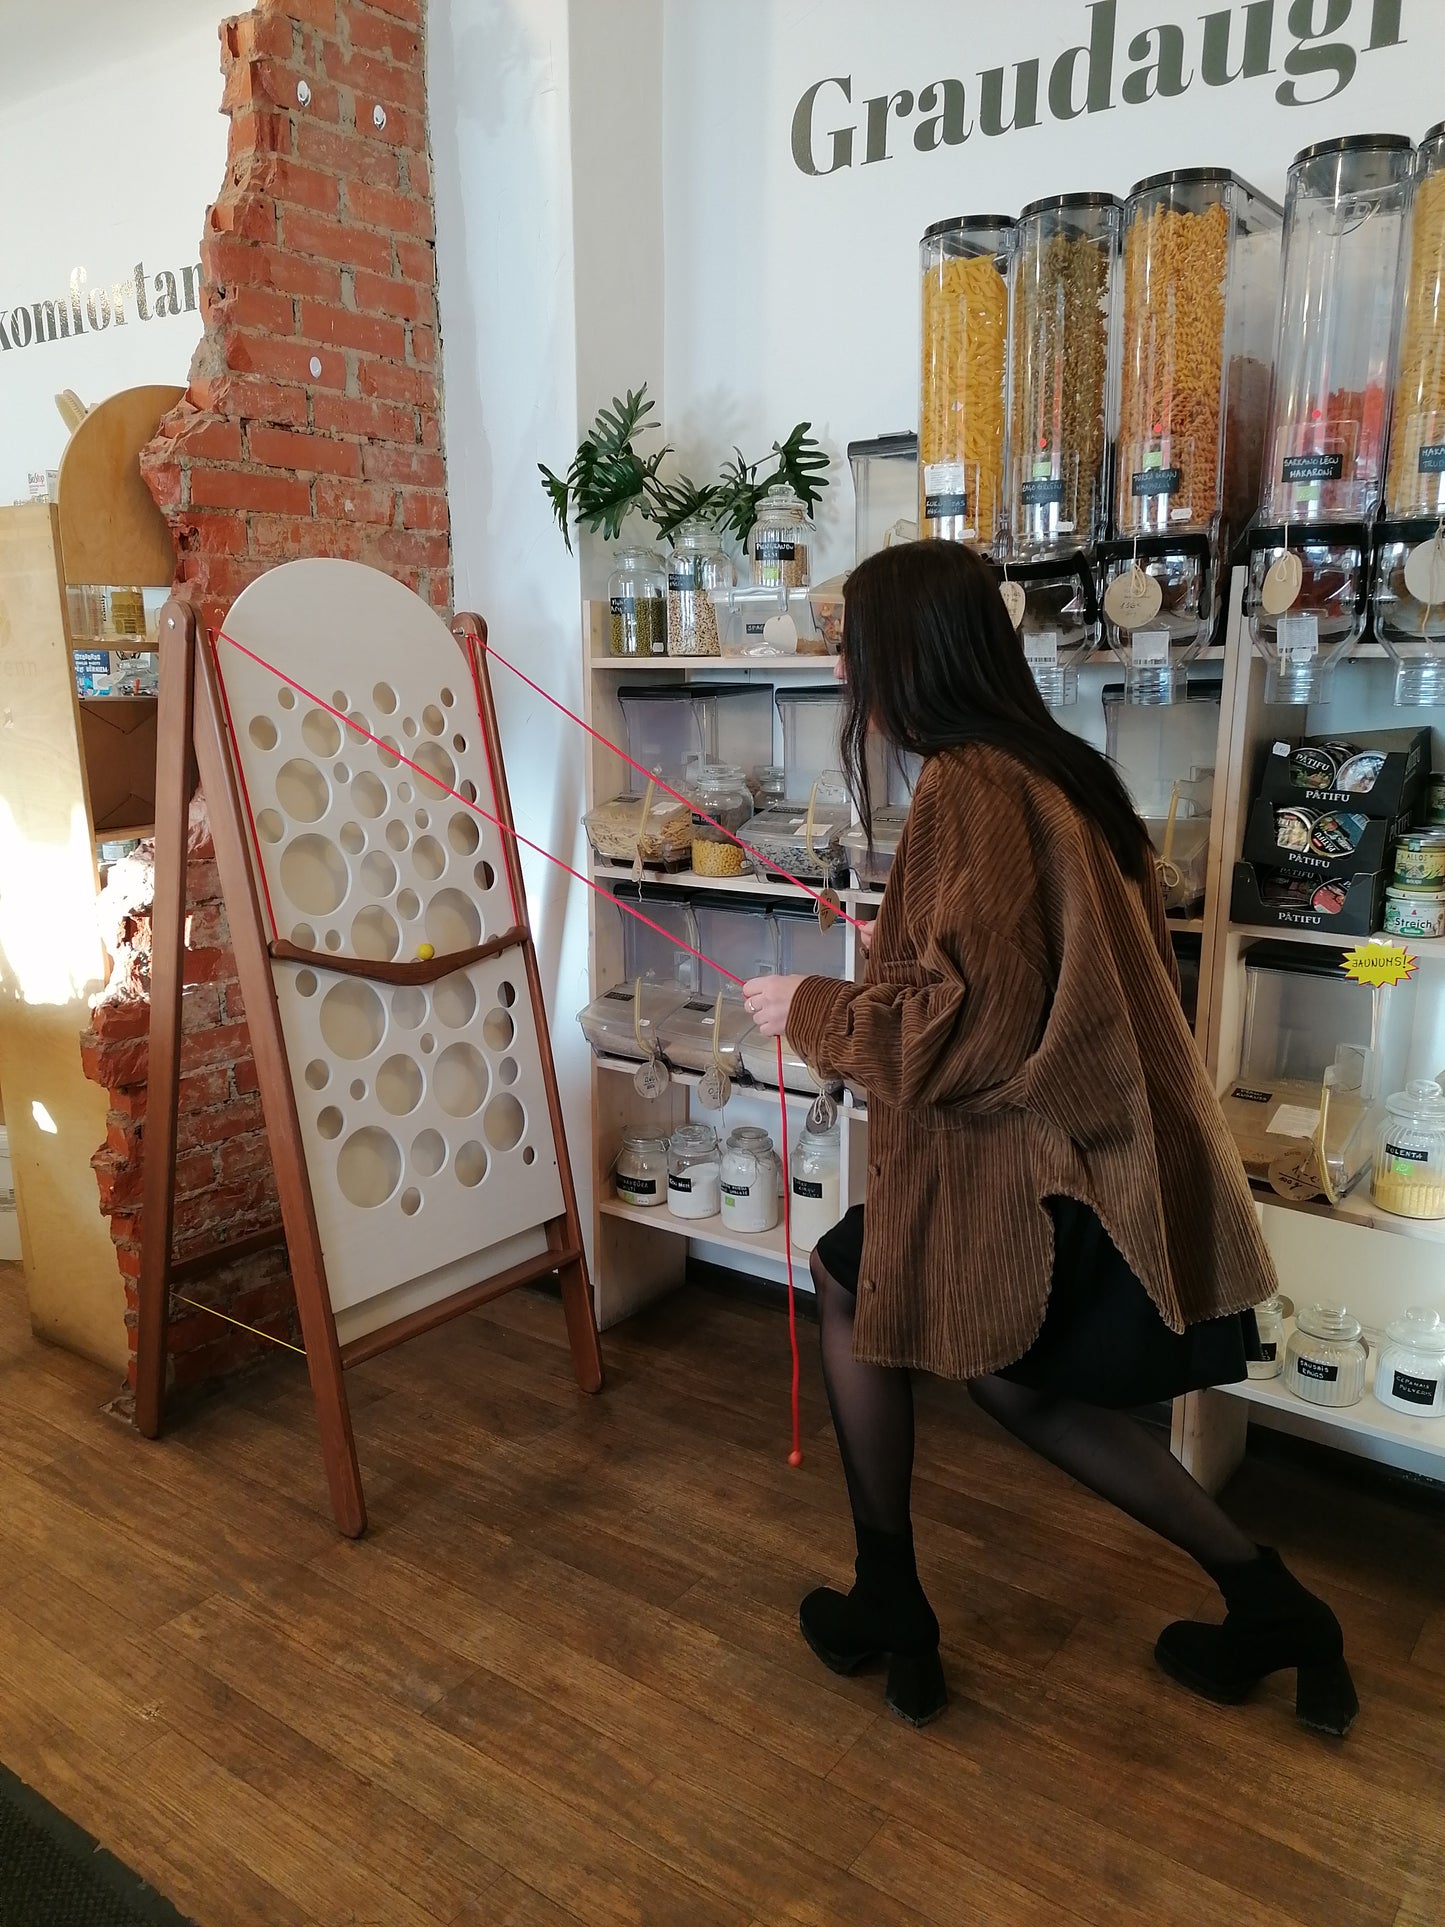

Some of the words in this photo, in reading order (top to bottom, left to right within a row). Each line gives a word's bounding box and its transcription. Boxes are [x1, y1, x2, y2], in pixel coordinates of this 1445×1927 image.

[1305, 790, 1351, 802] PÂTIFU
[1288, 853, 1331, 869] PÂTIFU
[1278, 911, 1321, 924] PÂTIFU
[1395, 917, 1433, 929] Streich
[1386, 1145, 1423, 1159] POLENTA
